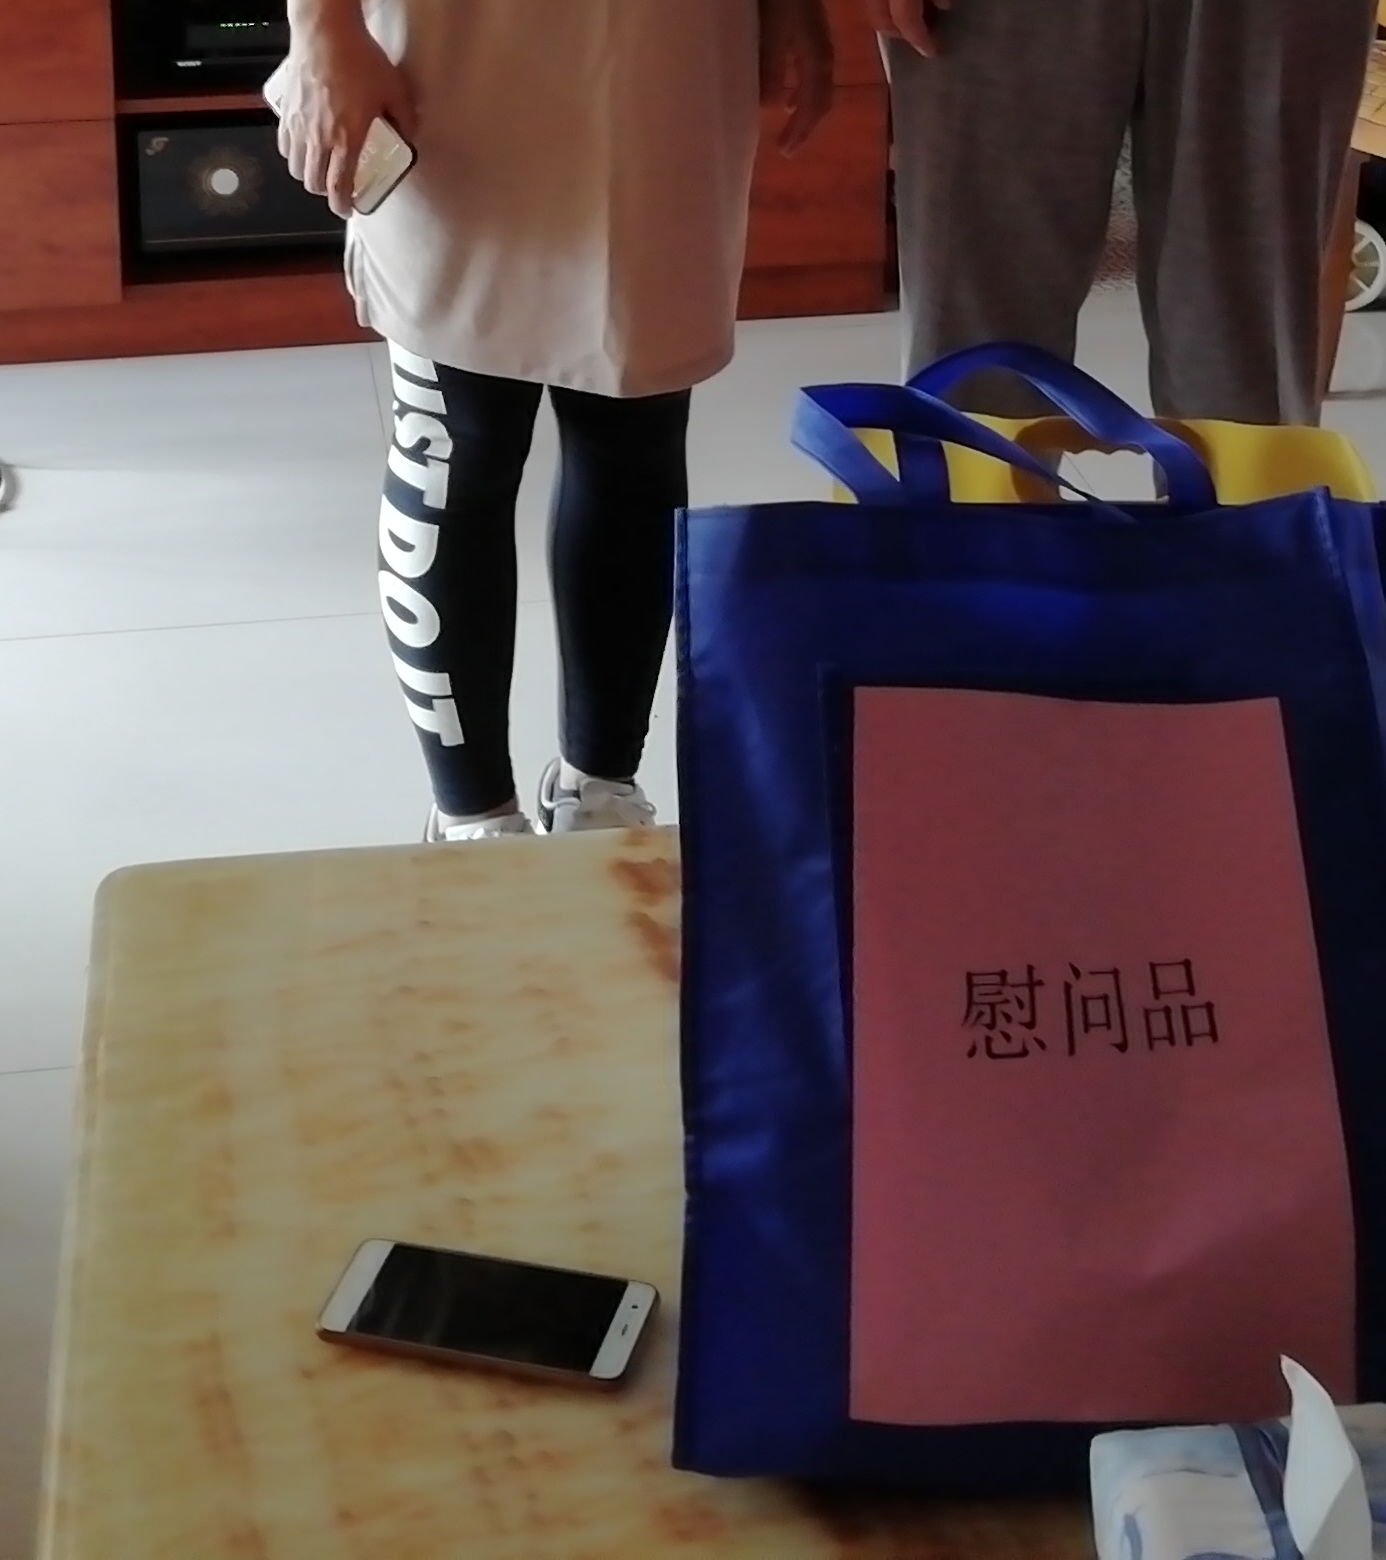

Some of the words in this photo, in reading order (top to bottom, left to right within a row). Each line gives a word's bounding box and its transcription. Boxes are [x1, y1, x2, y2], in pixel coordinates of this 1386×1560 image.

[387, 337, 454, 510] UST
[378, 493, 442, 649] DO
[391, 650, 466, 748] IT
[961, 958, 1219, 1060] 慰问品
